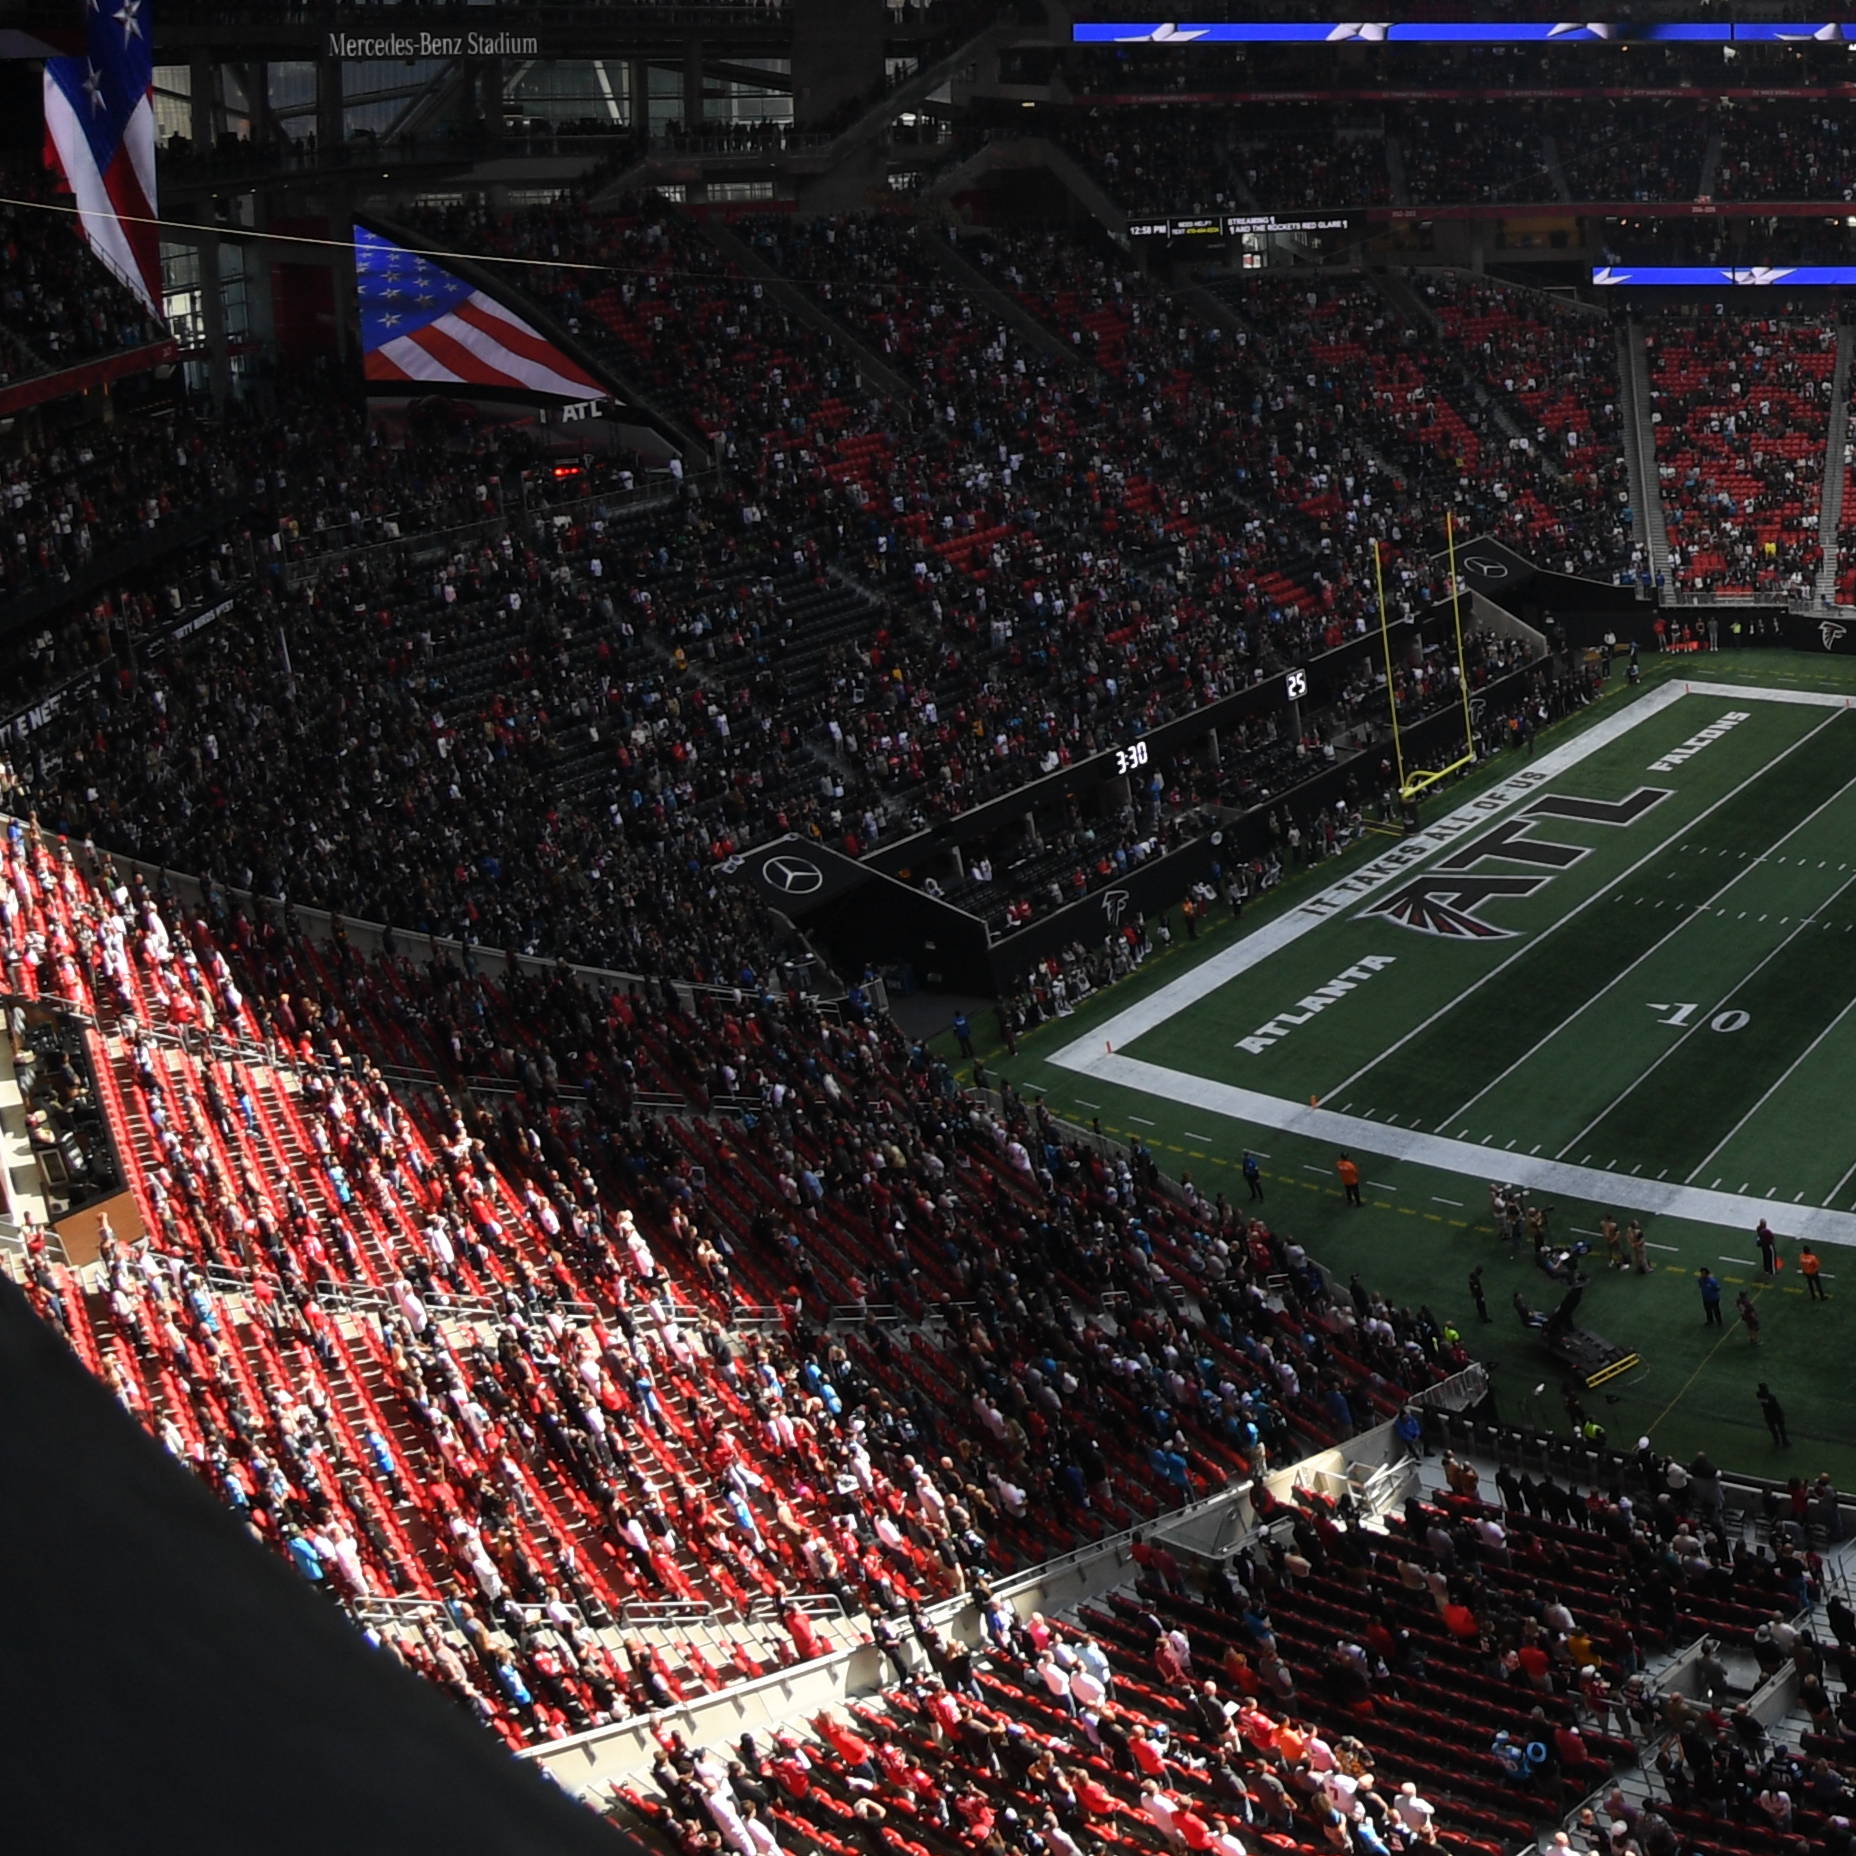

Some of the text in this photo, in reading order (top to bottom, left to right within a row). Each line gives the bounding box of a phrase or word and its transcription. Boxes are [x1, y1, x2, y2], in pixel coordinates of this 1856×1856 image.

[328, 30, 539, 57] Mercedes-Benz Stadium
[1287, 672, 1306, 697] 25
[1115, 741, 1148, 775] 3:30
[1645, 710, 1751, 774] FALCONS
[1299, 768, 1548, 916] IT TAKES ALL OF US
[1344, 783, 1678, 942] ATL
[1233, 952, 1399, 1056] ATLANTA
[1656, 1001, 1751, 1033] 10
